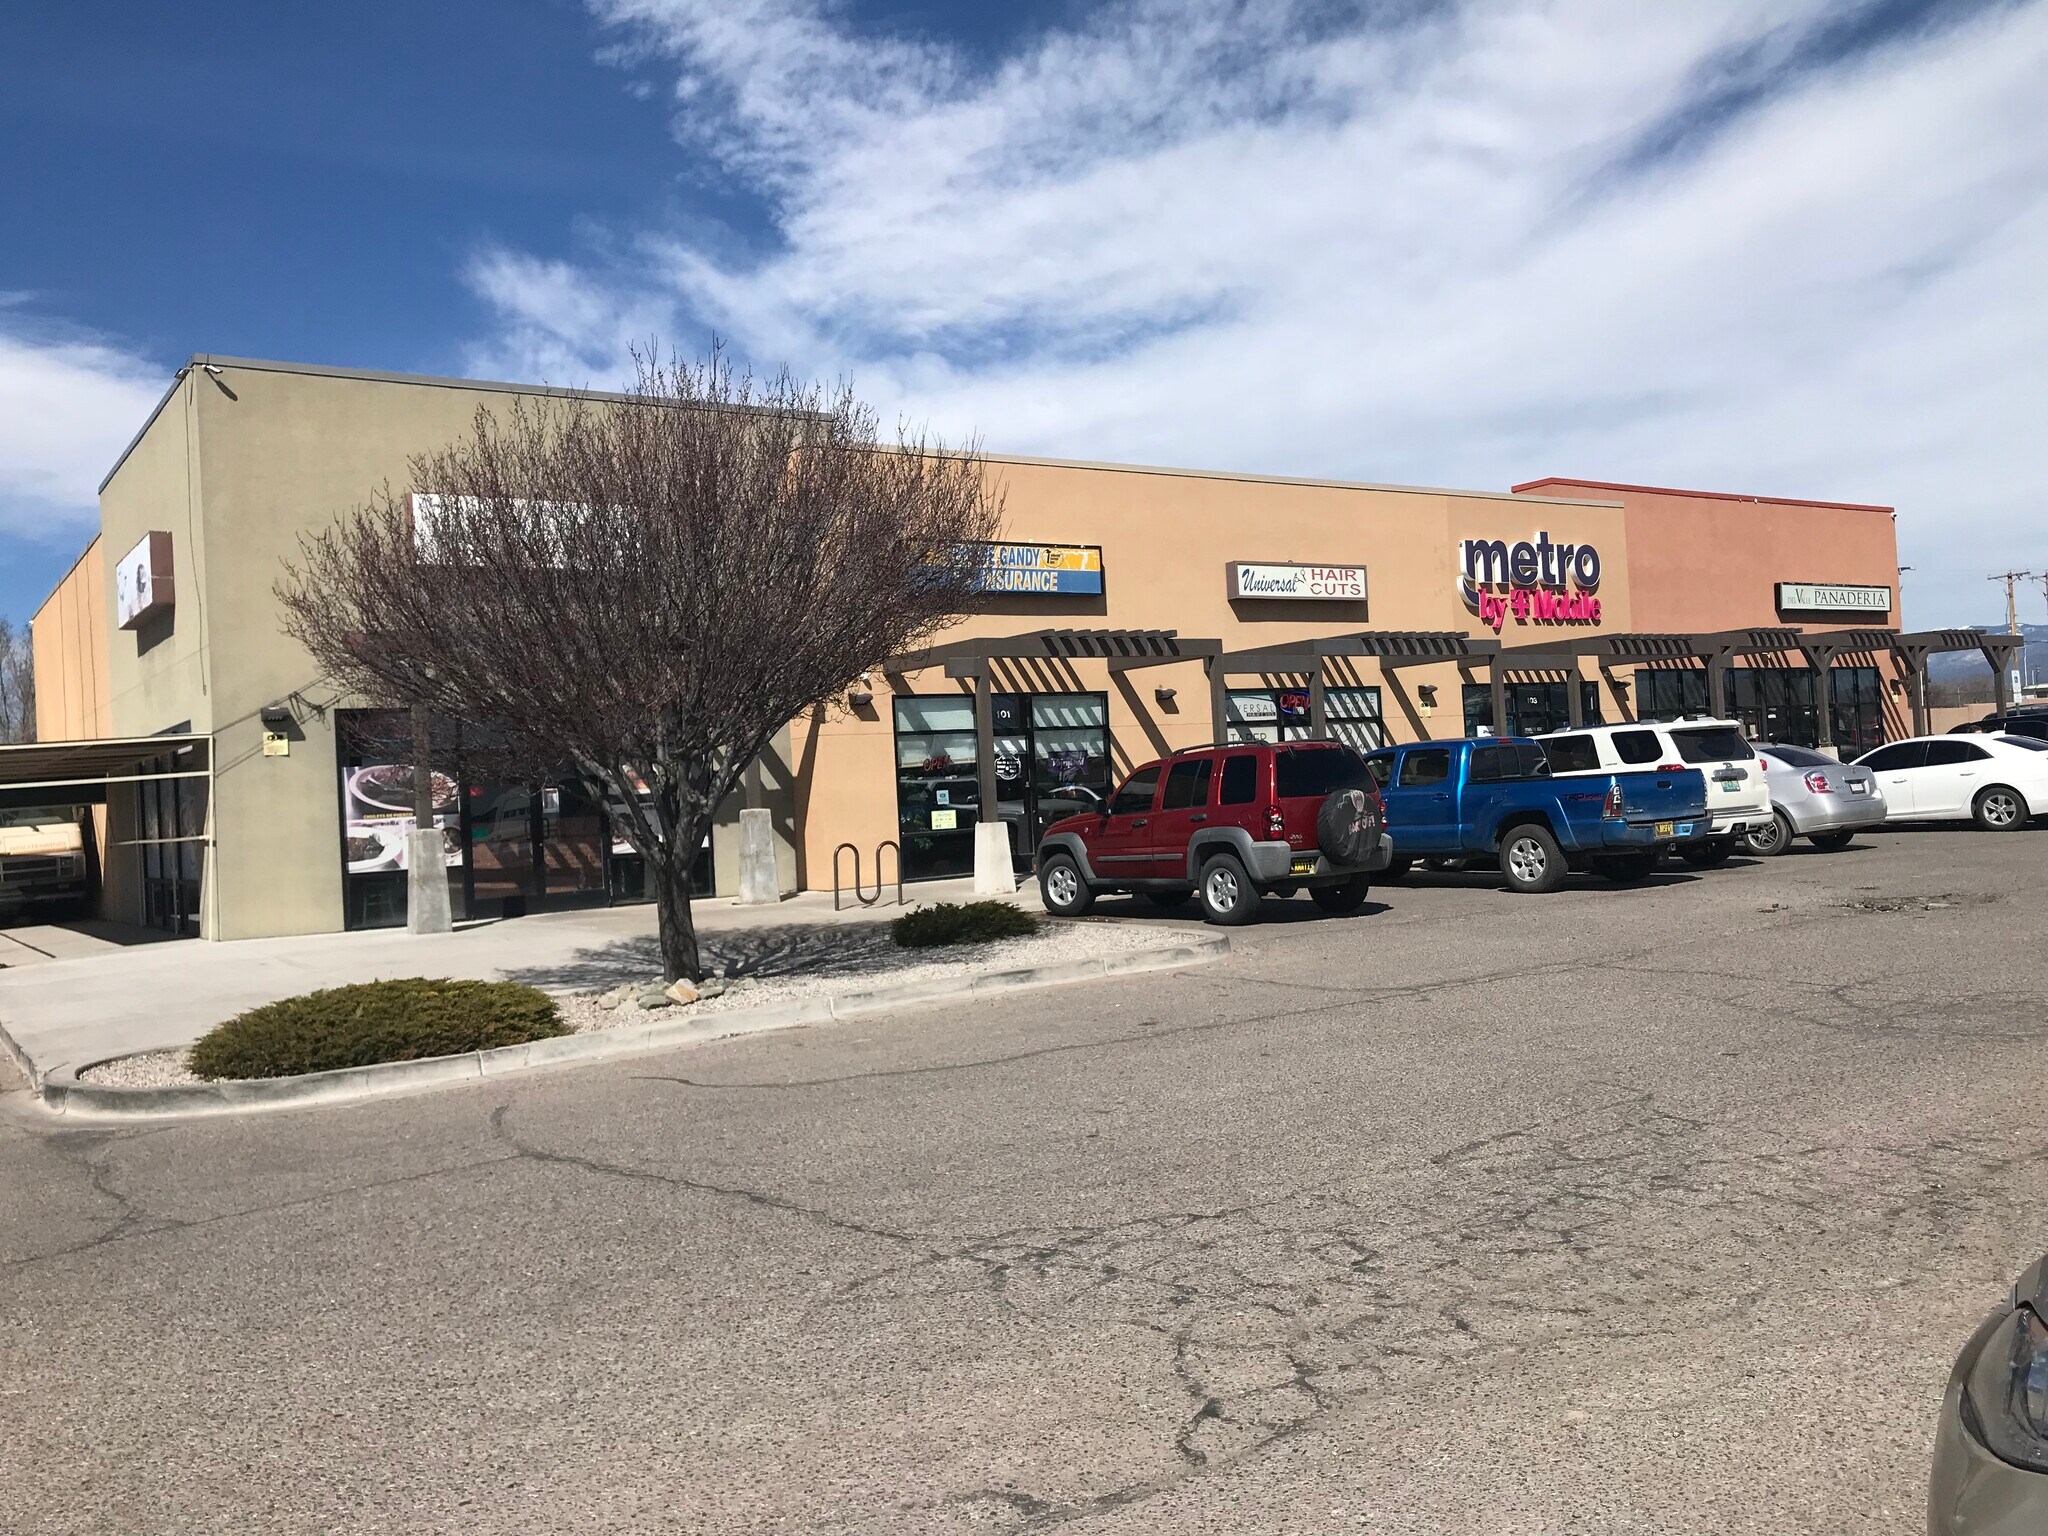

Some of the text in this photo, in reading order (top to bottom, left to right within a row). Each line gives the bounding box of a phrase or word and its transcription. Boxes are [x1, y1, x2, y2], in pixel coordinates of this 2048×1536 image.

[1000, 546, 1040, 567] GANDY
[1461, 531, 1601, 586] metro
[1242, 568, 1298, 593] Universal
[1311, 569, 1358, 581] HAIR
[1310, 583, 1361, 595] CUTS
[1814, 591, 1885, 605] PANADERIA
[1478, 589, 1508, 629] by
[1280, 694, 1311, 710] OPEN
[996, 710, 1011, 718] 101
